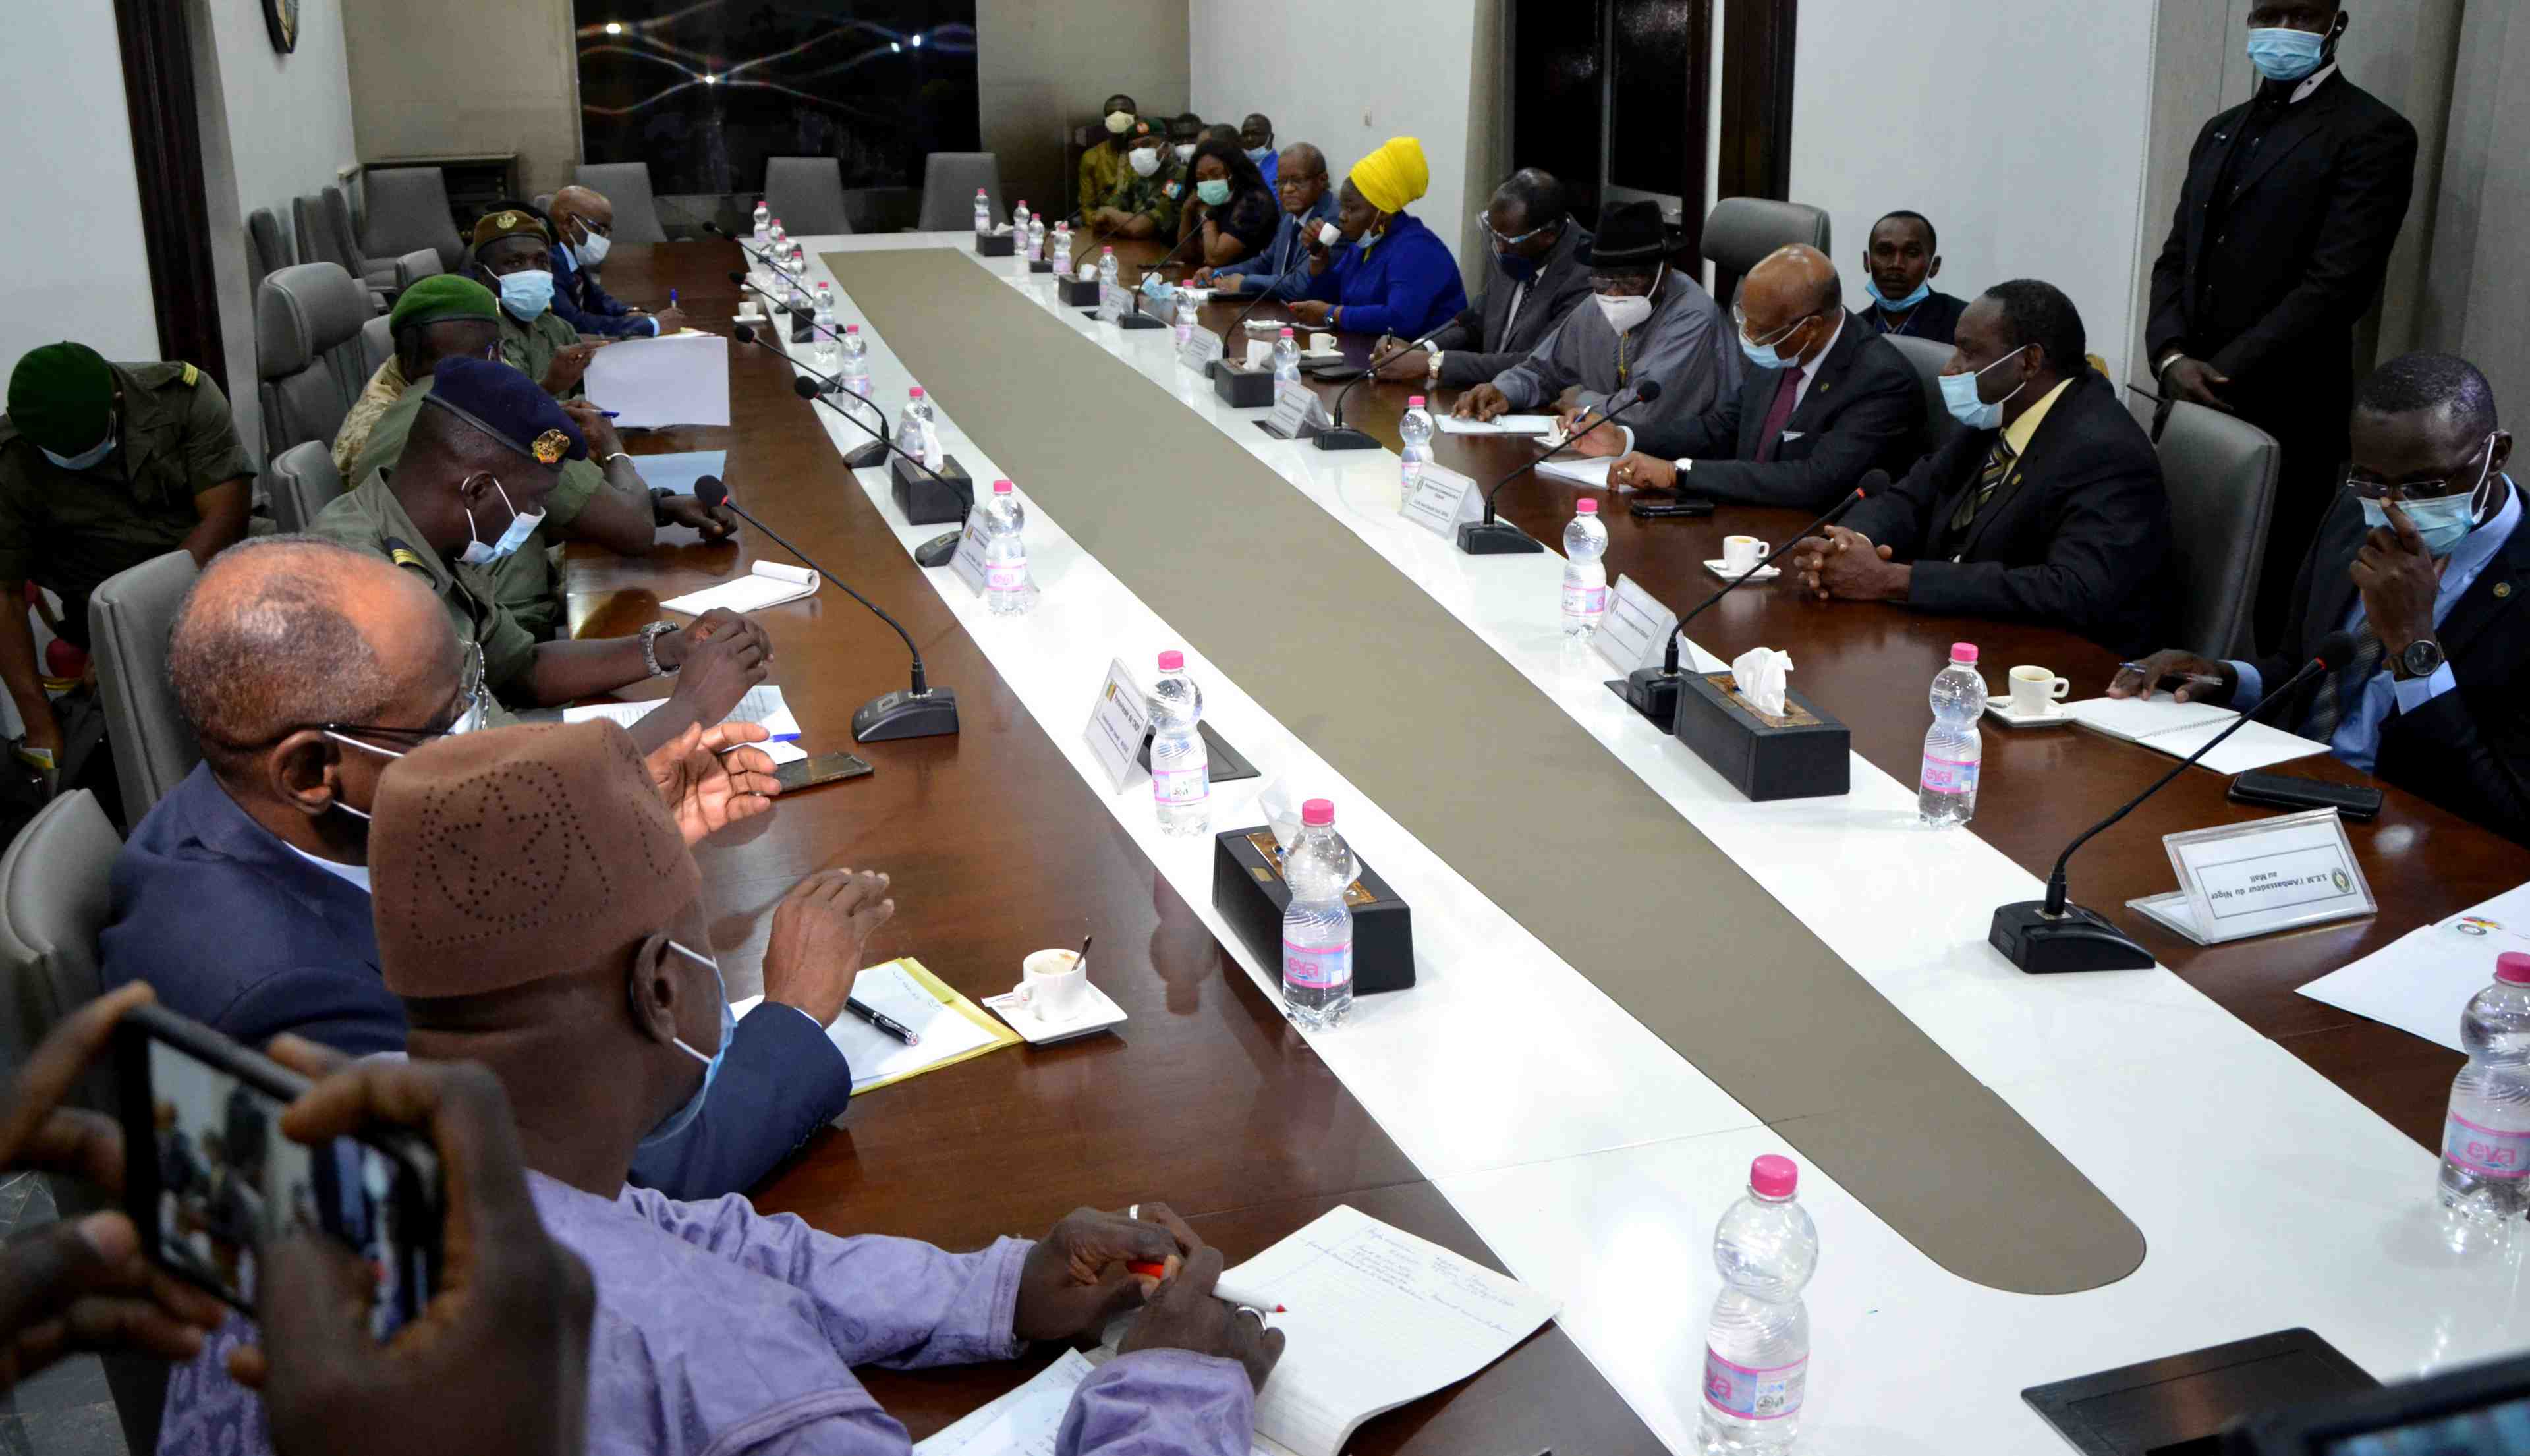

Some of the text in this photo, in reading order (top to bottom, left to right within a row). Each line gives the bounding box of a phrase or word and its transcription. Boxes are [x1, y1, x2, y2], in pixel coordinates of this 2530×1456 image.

[1926, 768, 1952, 783] eva
[2249, 873, 2268, 883] Mali
[2249, 879, 2305, 893] l'Ambassadeur
[2210, 889, 2233, 901] Niger
[1288, 957, 1318, 976] eva
[2467, 1142, 2516, 1165] eva
